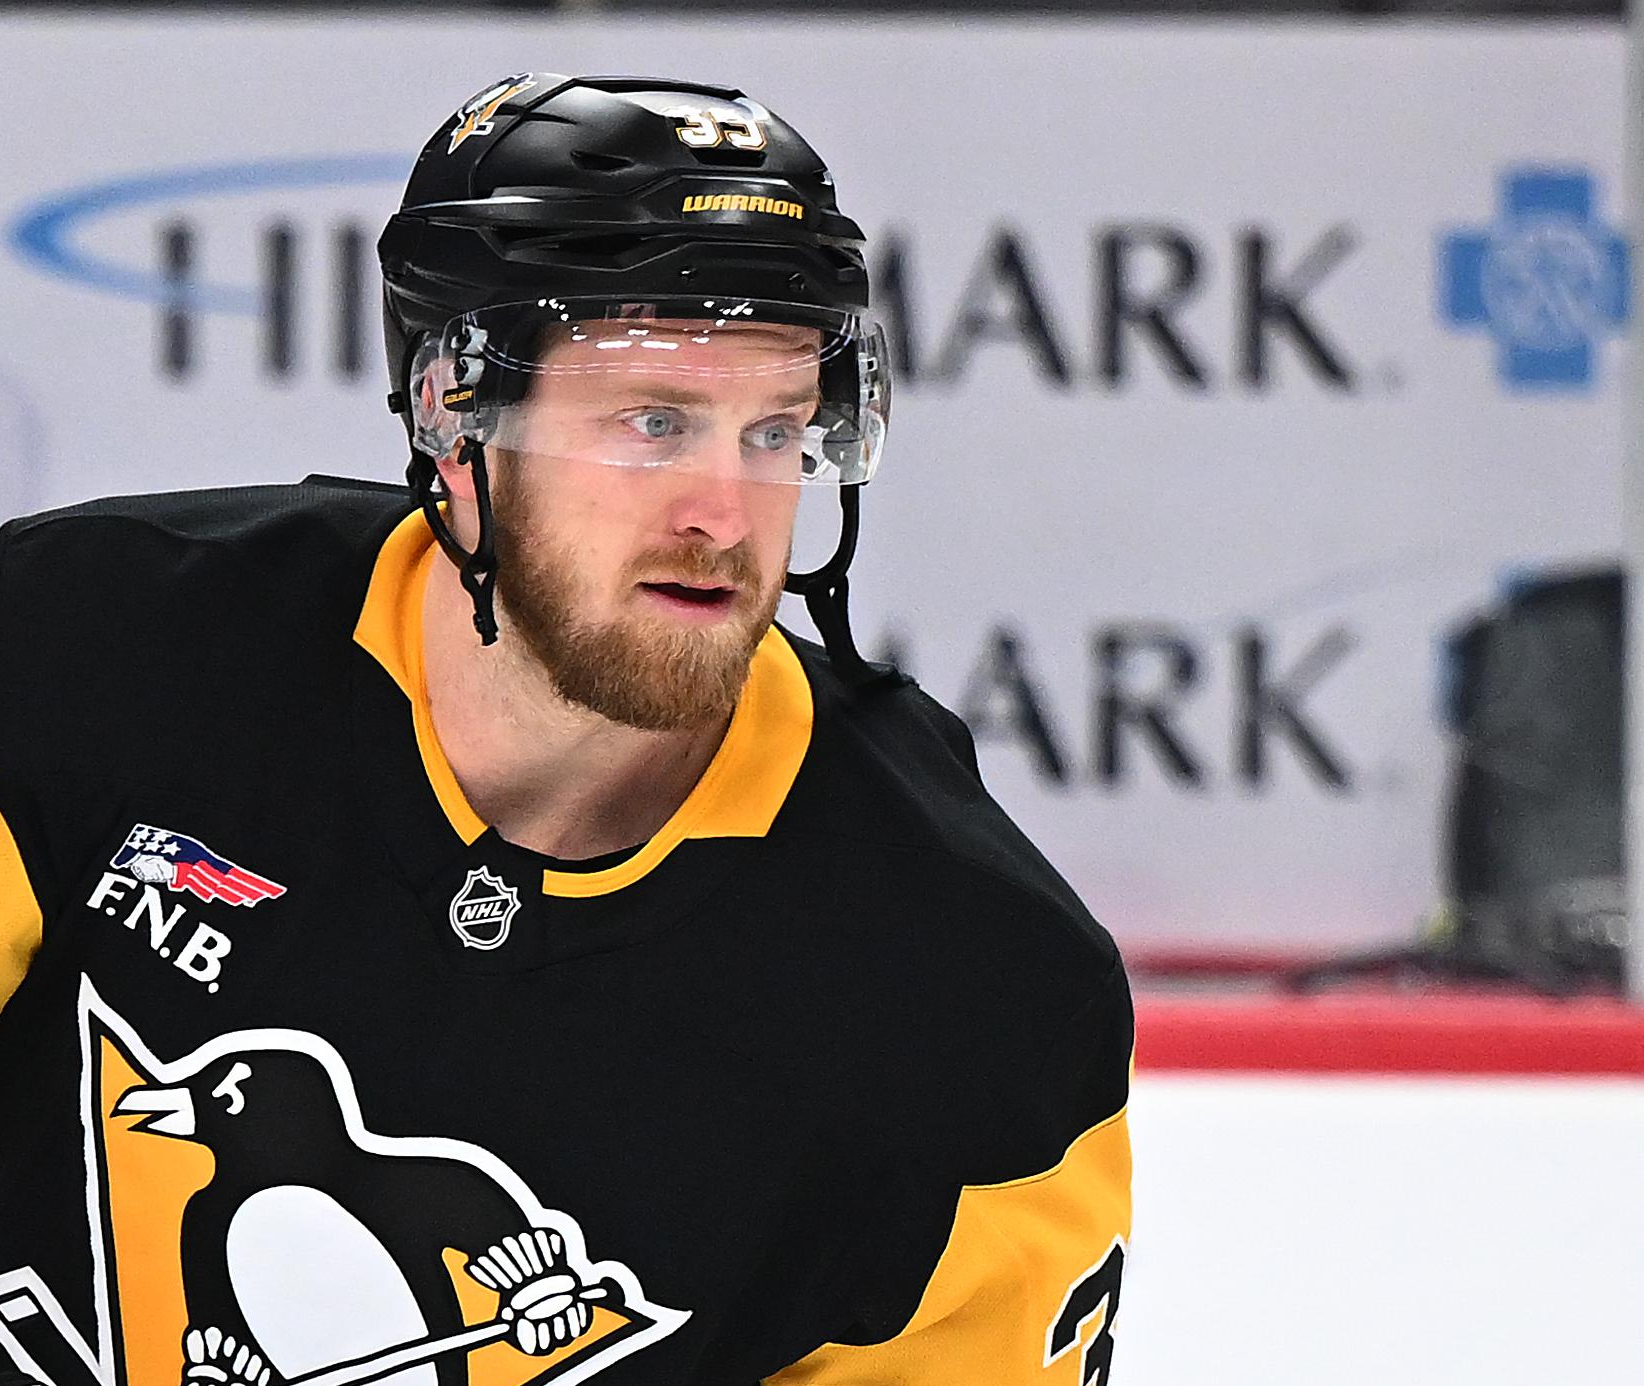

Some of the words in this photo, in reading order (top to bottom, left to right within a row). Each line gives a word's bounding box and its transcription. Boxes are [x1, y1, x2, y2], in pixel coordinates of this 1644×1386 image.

[682, 194, 805, 220] WARRIOR
[944, 618, 1362, 791] ARK
[86, 871, 233, 994] F.N.B.
[460, 901, 505, 922] NHL
